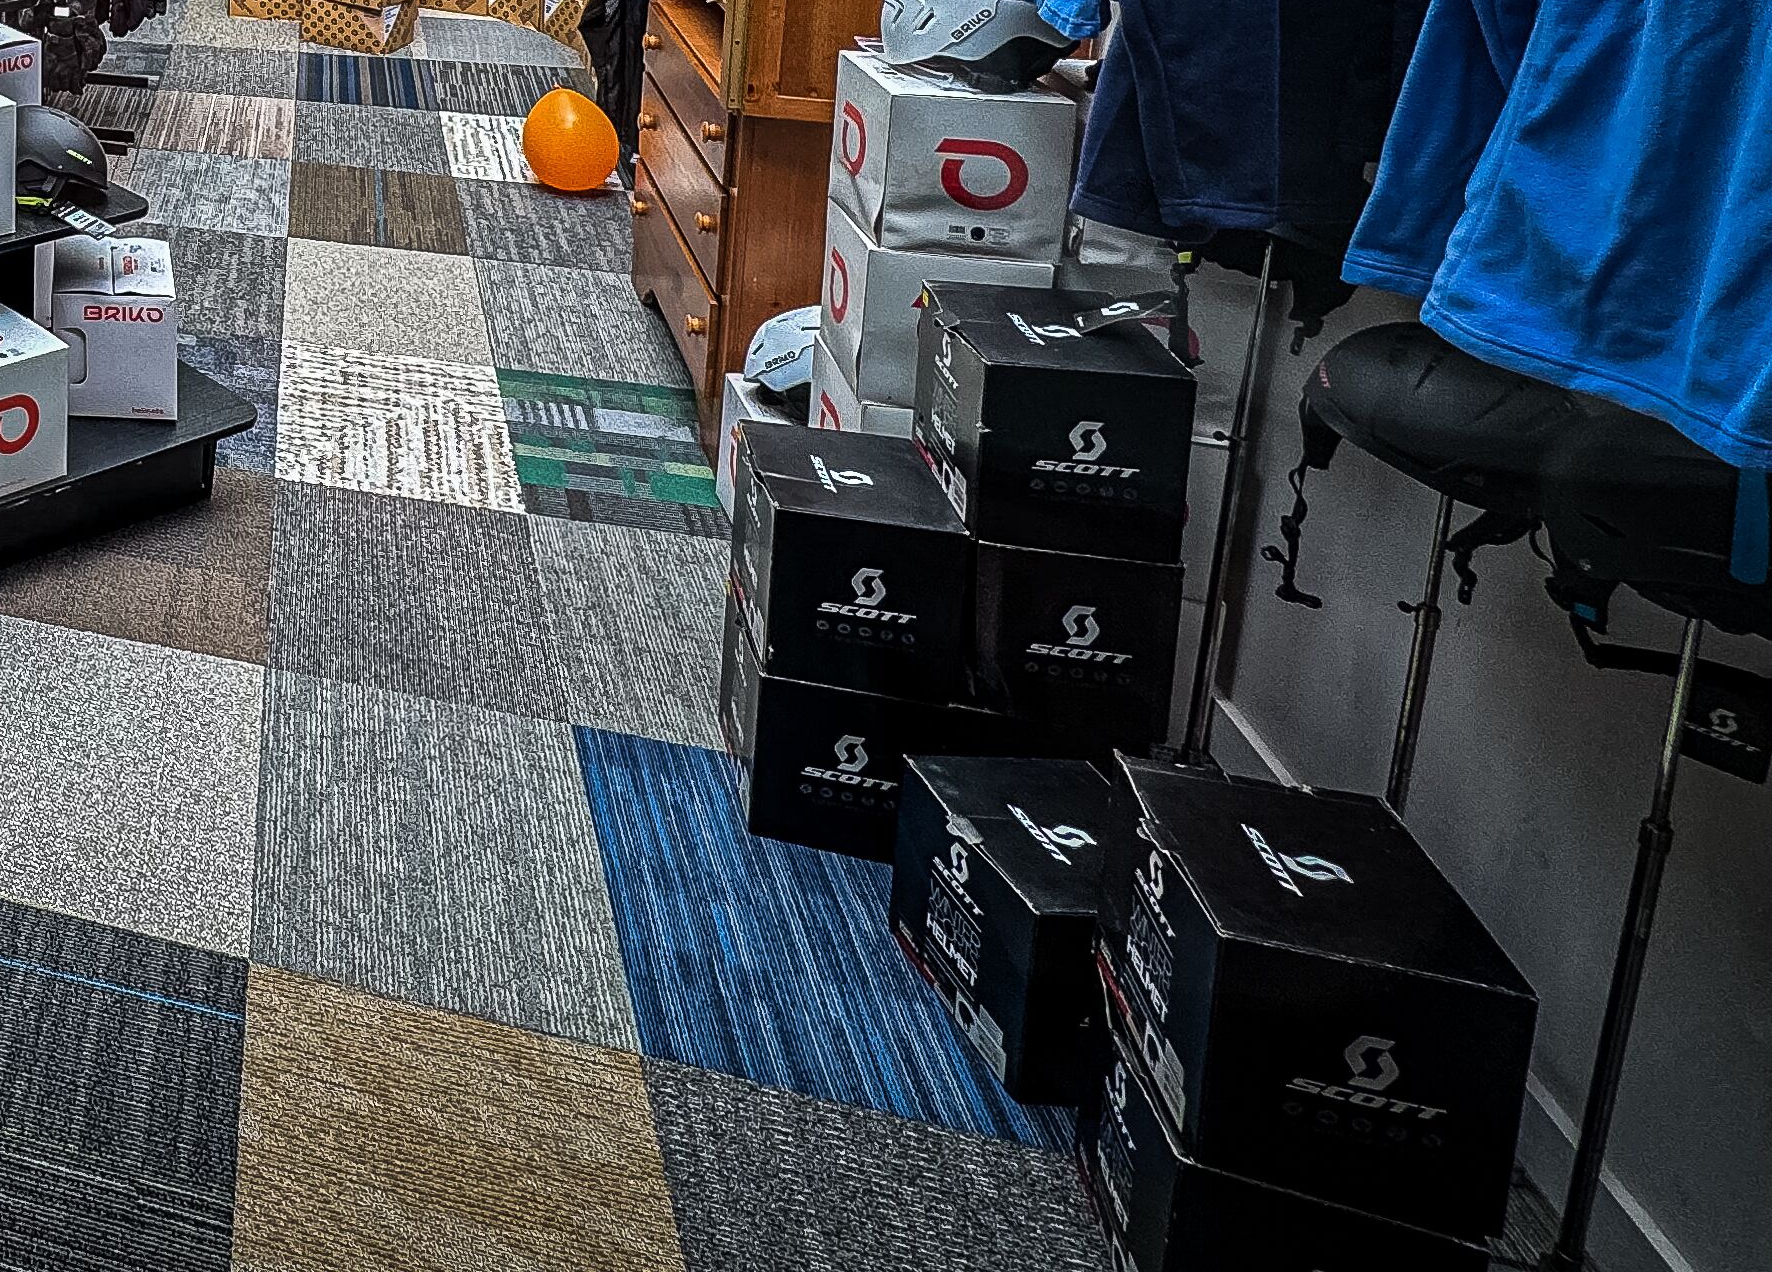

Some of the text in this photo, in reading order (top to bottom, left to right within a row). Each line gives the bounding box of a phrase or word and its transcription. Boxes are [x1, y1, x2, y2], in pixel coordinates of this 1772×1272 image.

[950, 9, 993, 40] BRIKO
[84, 306, 165, 323] BRIKO
[1006, 312, 1046, 346] SCOTT
[810, 454, 838, 494] SCOTT
[1031, 460, 1141, 478] SCOTT
[816, 602, 917, 624] SCOTT
[1025, 642, 1133, 665] SCOTT
[800, 766, 899, 791] SCOTT
[1006, 803, 1072, 866] SCOTT
[1240, 822, 1304, 897] SCOTT
[932, 855, 985, 916] SCOTT
[1134, 867, 1176, 938] SCOTT
[926, 911, 978, 987] HELMET
[1126, 934, 1167, 1024] HELMET
[1285, 1077, 1448, 1121] SCOTT
